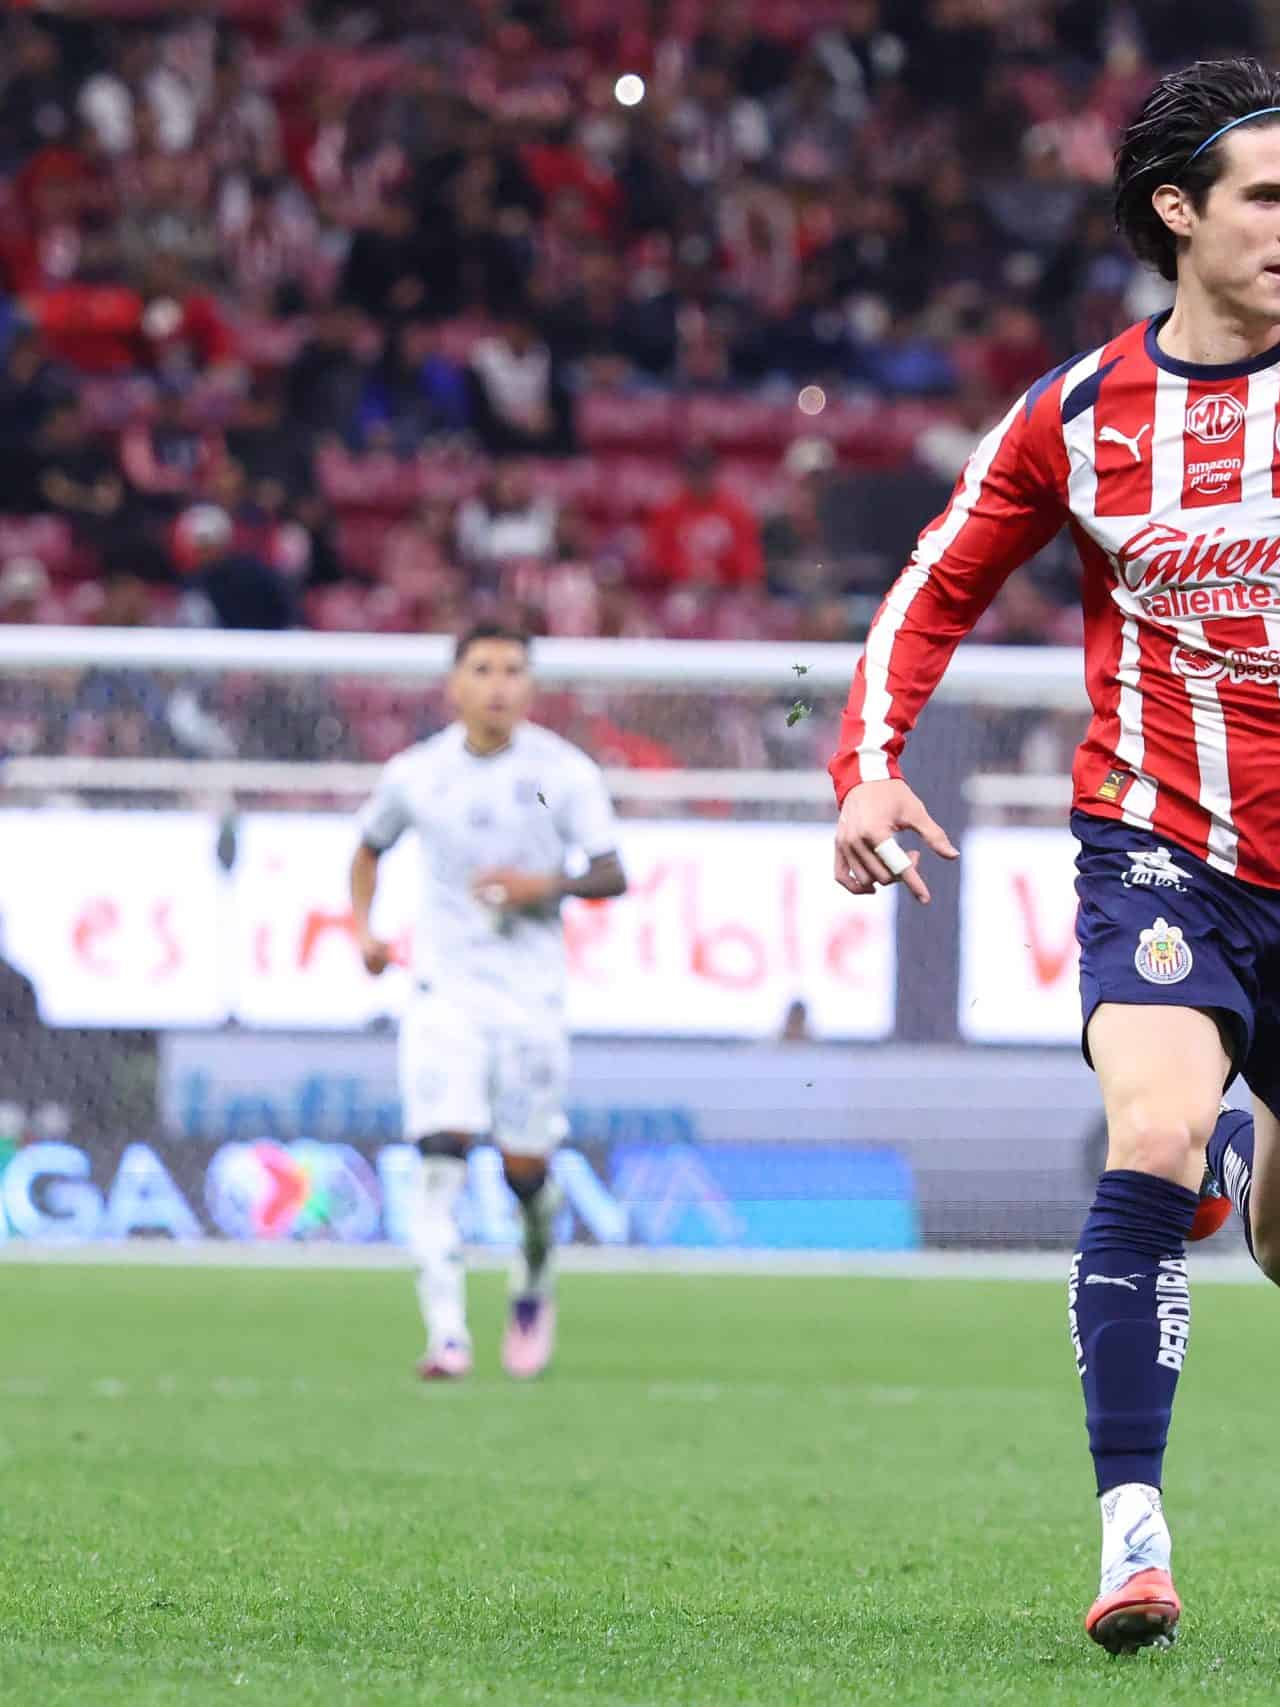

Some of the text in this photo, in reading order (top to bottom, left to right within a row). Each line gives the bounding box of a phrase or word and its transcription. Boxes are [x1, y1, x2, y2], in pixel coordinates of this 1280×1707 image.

[1191, 400, 1239, 438] MG
[1187, 458, 1241, 475] amazon
[1190, 469, 1232, 488] prime
